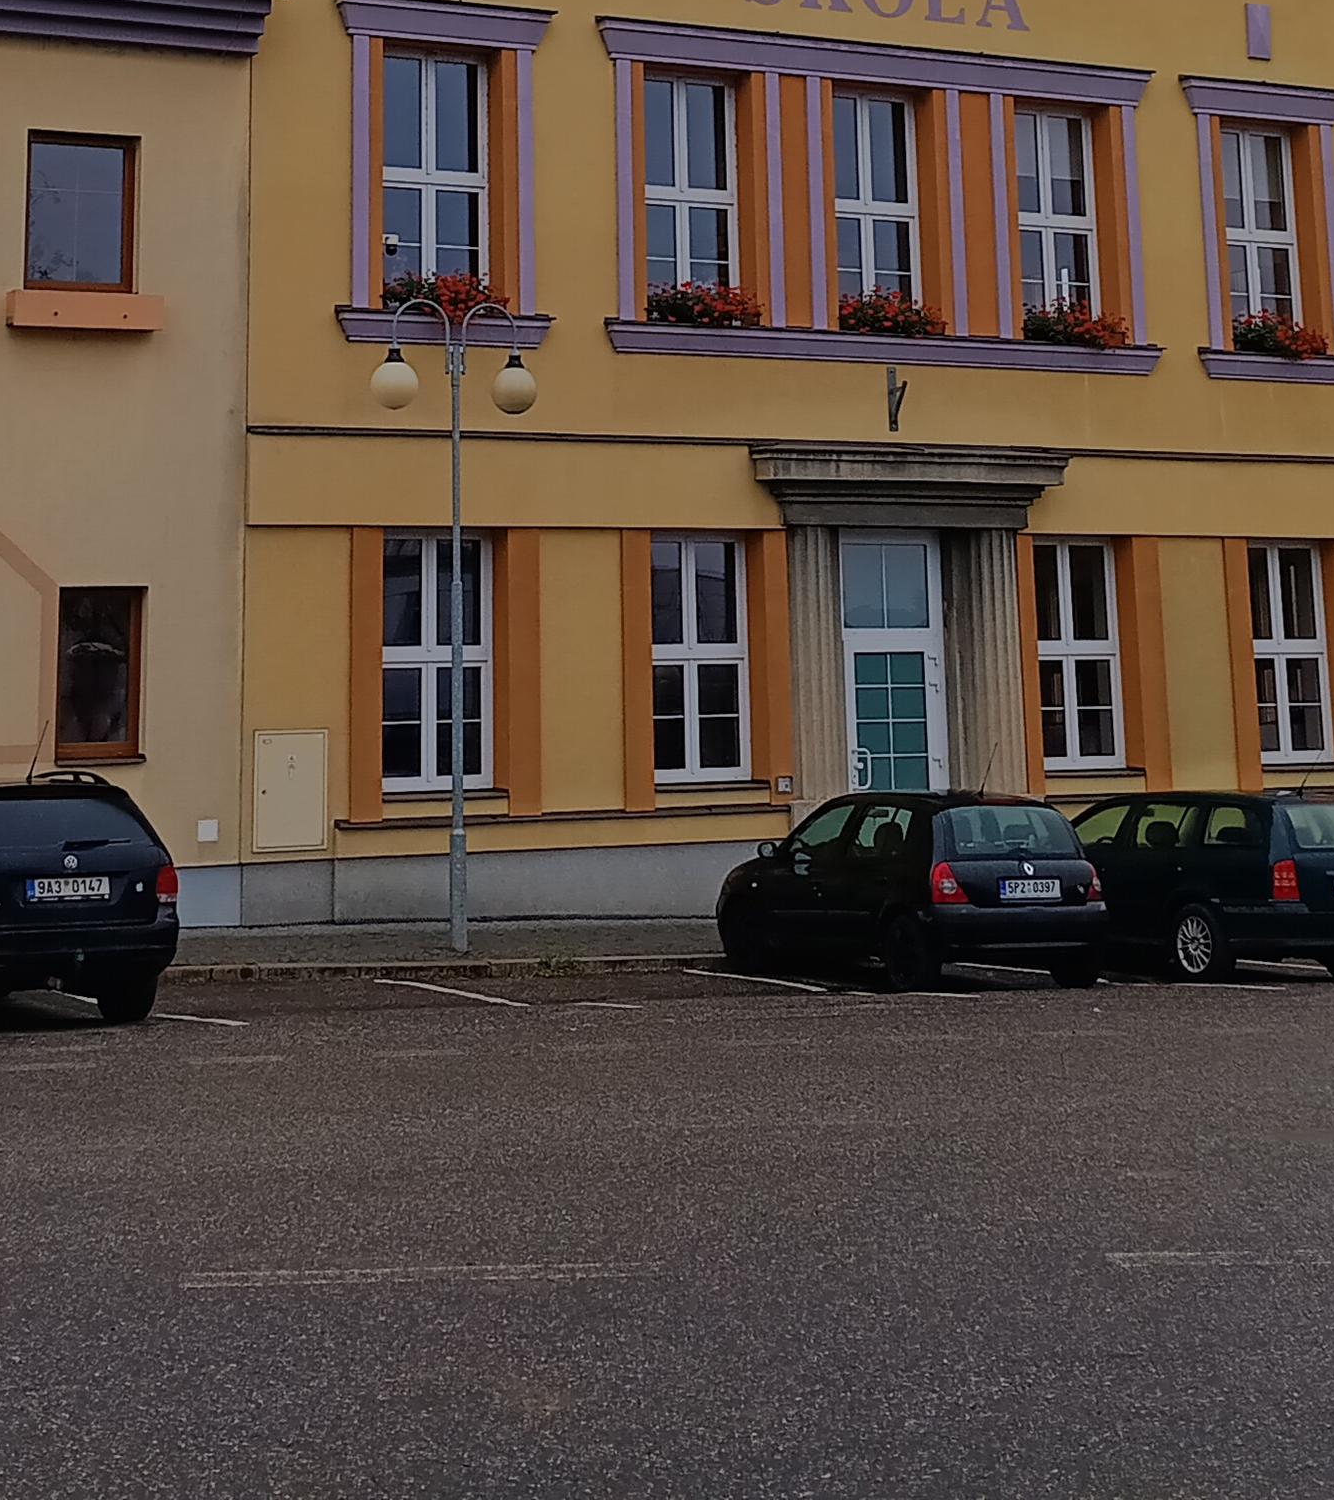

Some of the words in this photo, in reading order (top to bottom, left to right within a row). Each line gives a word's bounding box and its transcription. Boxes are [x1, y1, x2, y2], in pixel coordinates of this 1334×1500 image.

[37, 880, 62, 895] 9A3
[71, 879, 103, 893] 0147
[1008, 881, 1026, 894] 5P2
[1032, 881, 1056, 894] 0397
